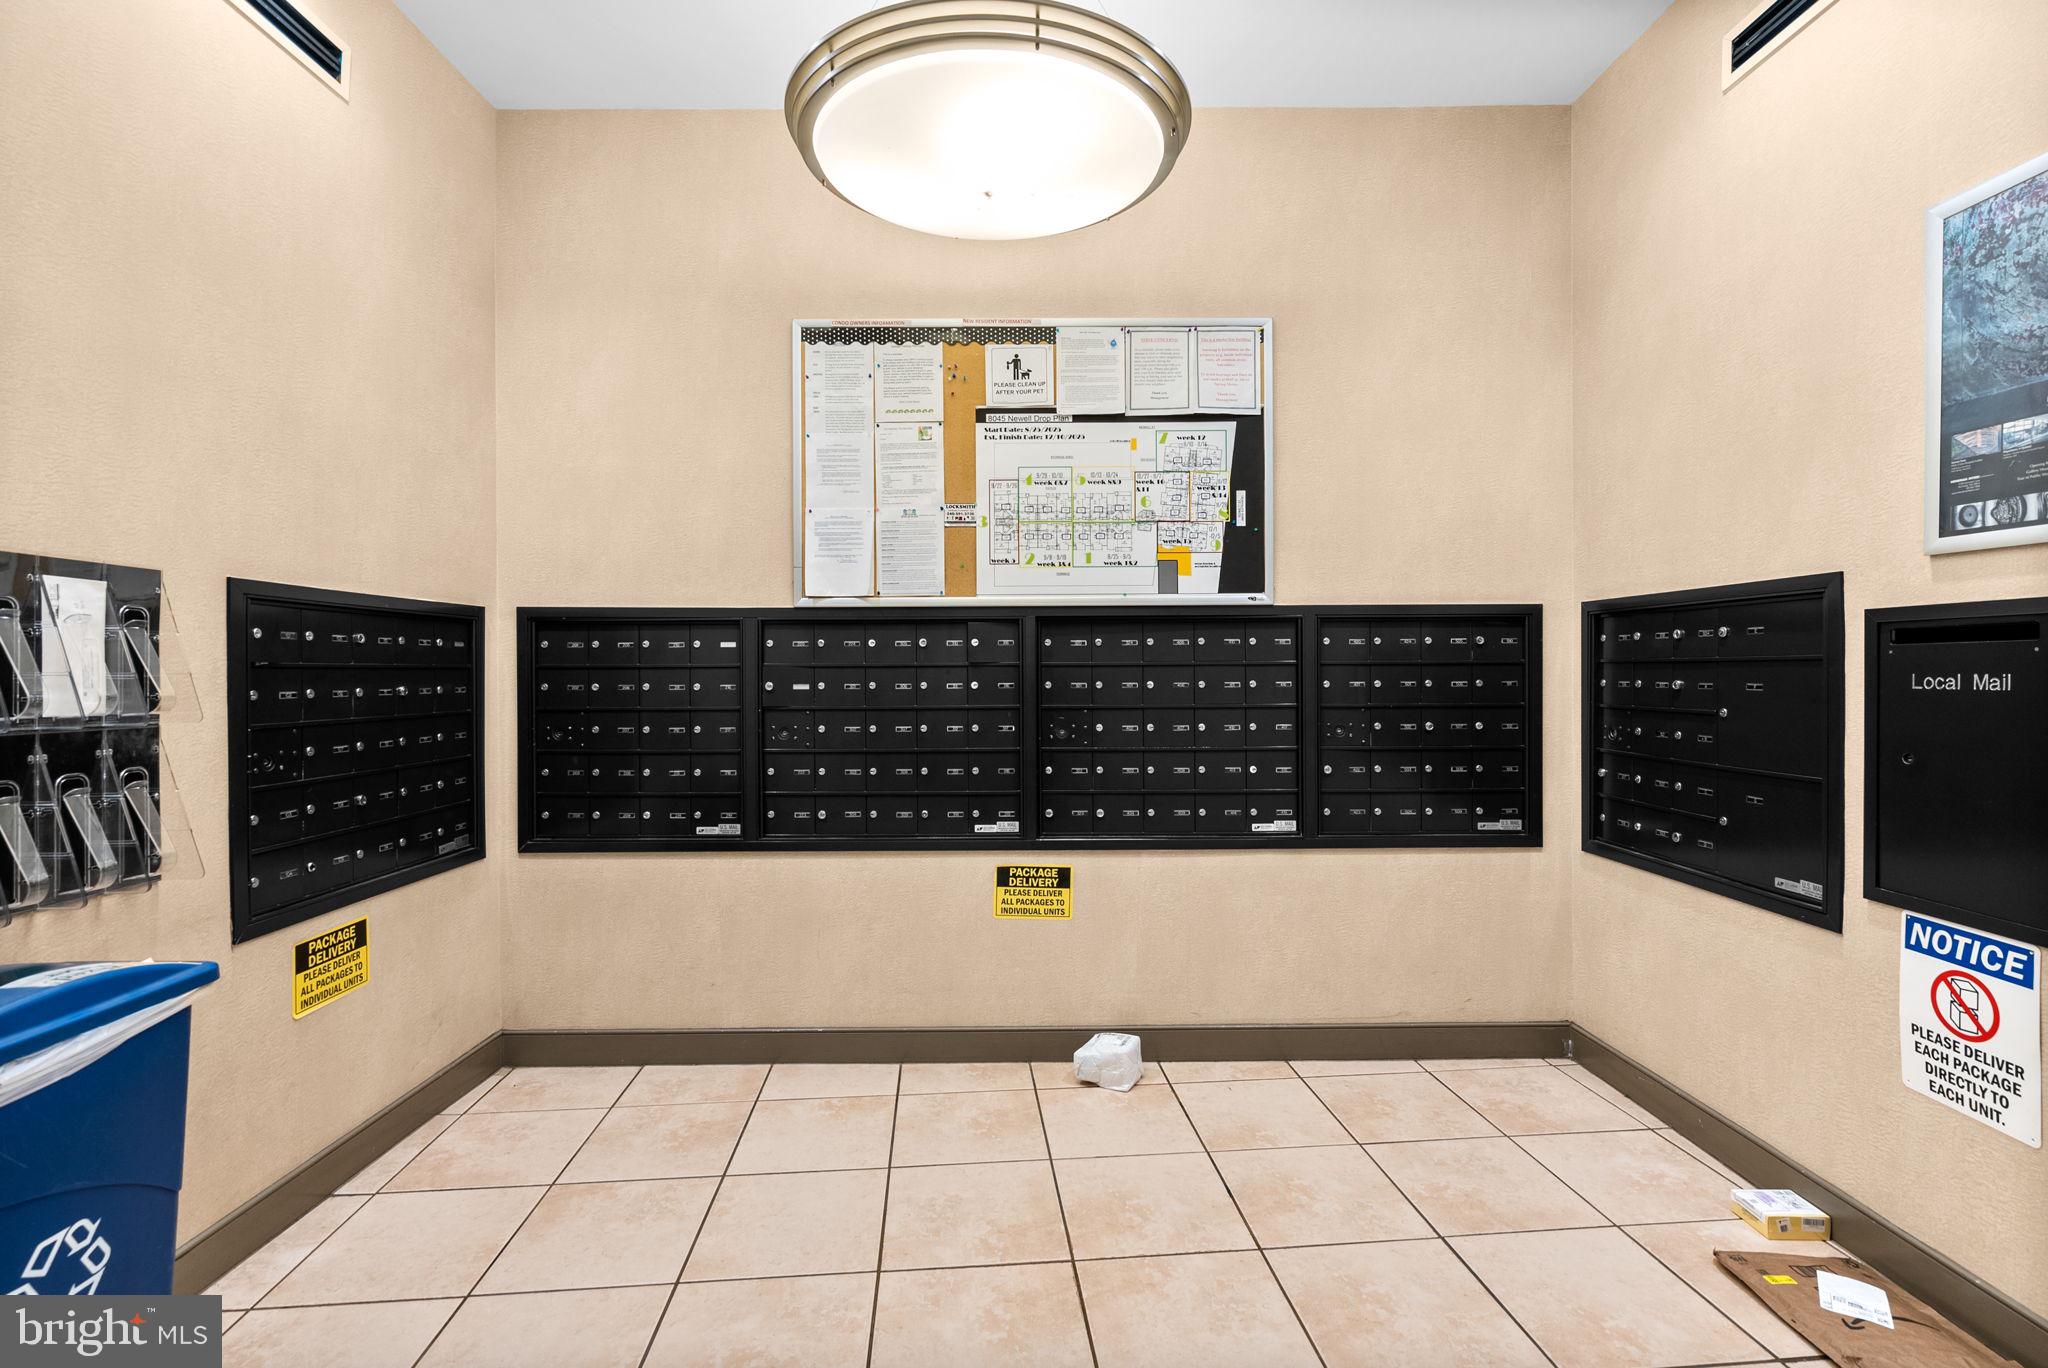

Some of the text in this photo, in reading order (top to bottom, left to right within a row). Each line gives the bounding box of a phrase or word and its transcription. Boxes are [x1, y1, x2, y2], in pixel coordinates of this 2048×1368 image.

[1912, 673, 2011, 691] Local Mail
[1008, 878, 1059, 887] DELIVERY
[1009, 868, 1058, 877] PACKAGE
[308, 925, 356, 954] PACKAGE
[308, 938, 357, 968] DELIVERY
[1910, 922, 2028, 980] NOTICE
[300, 962, 362, 997] ALL PACKAGES TO
[304, 951, 360, 983] PLEASE DELIVER
[301, 973, 364, 1010] INDIVIDUAL UNITS
[1912, 1023, 2024, 1080] PLEASE DELIVER
[1915, 1041, 2022, 1097] EACH PACKAGE
[1925, 1061, 2009, 1109] DIRECTLY TO
[1929, 1079, 2006, 1126] EACH UNIT.
